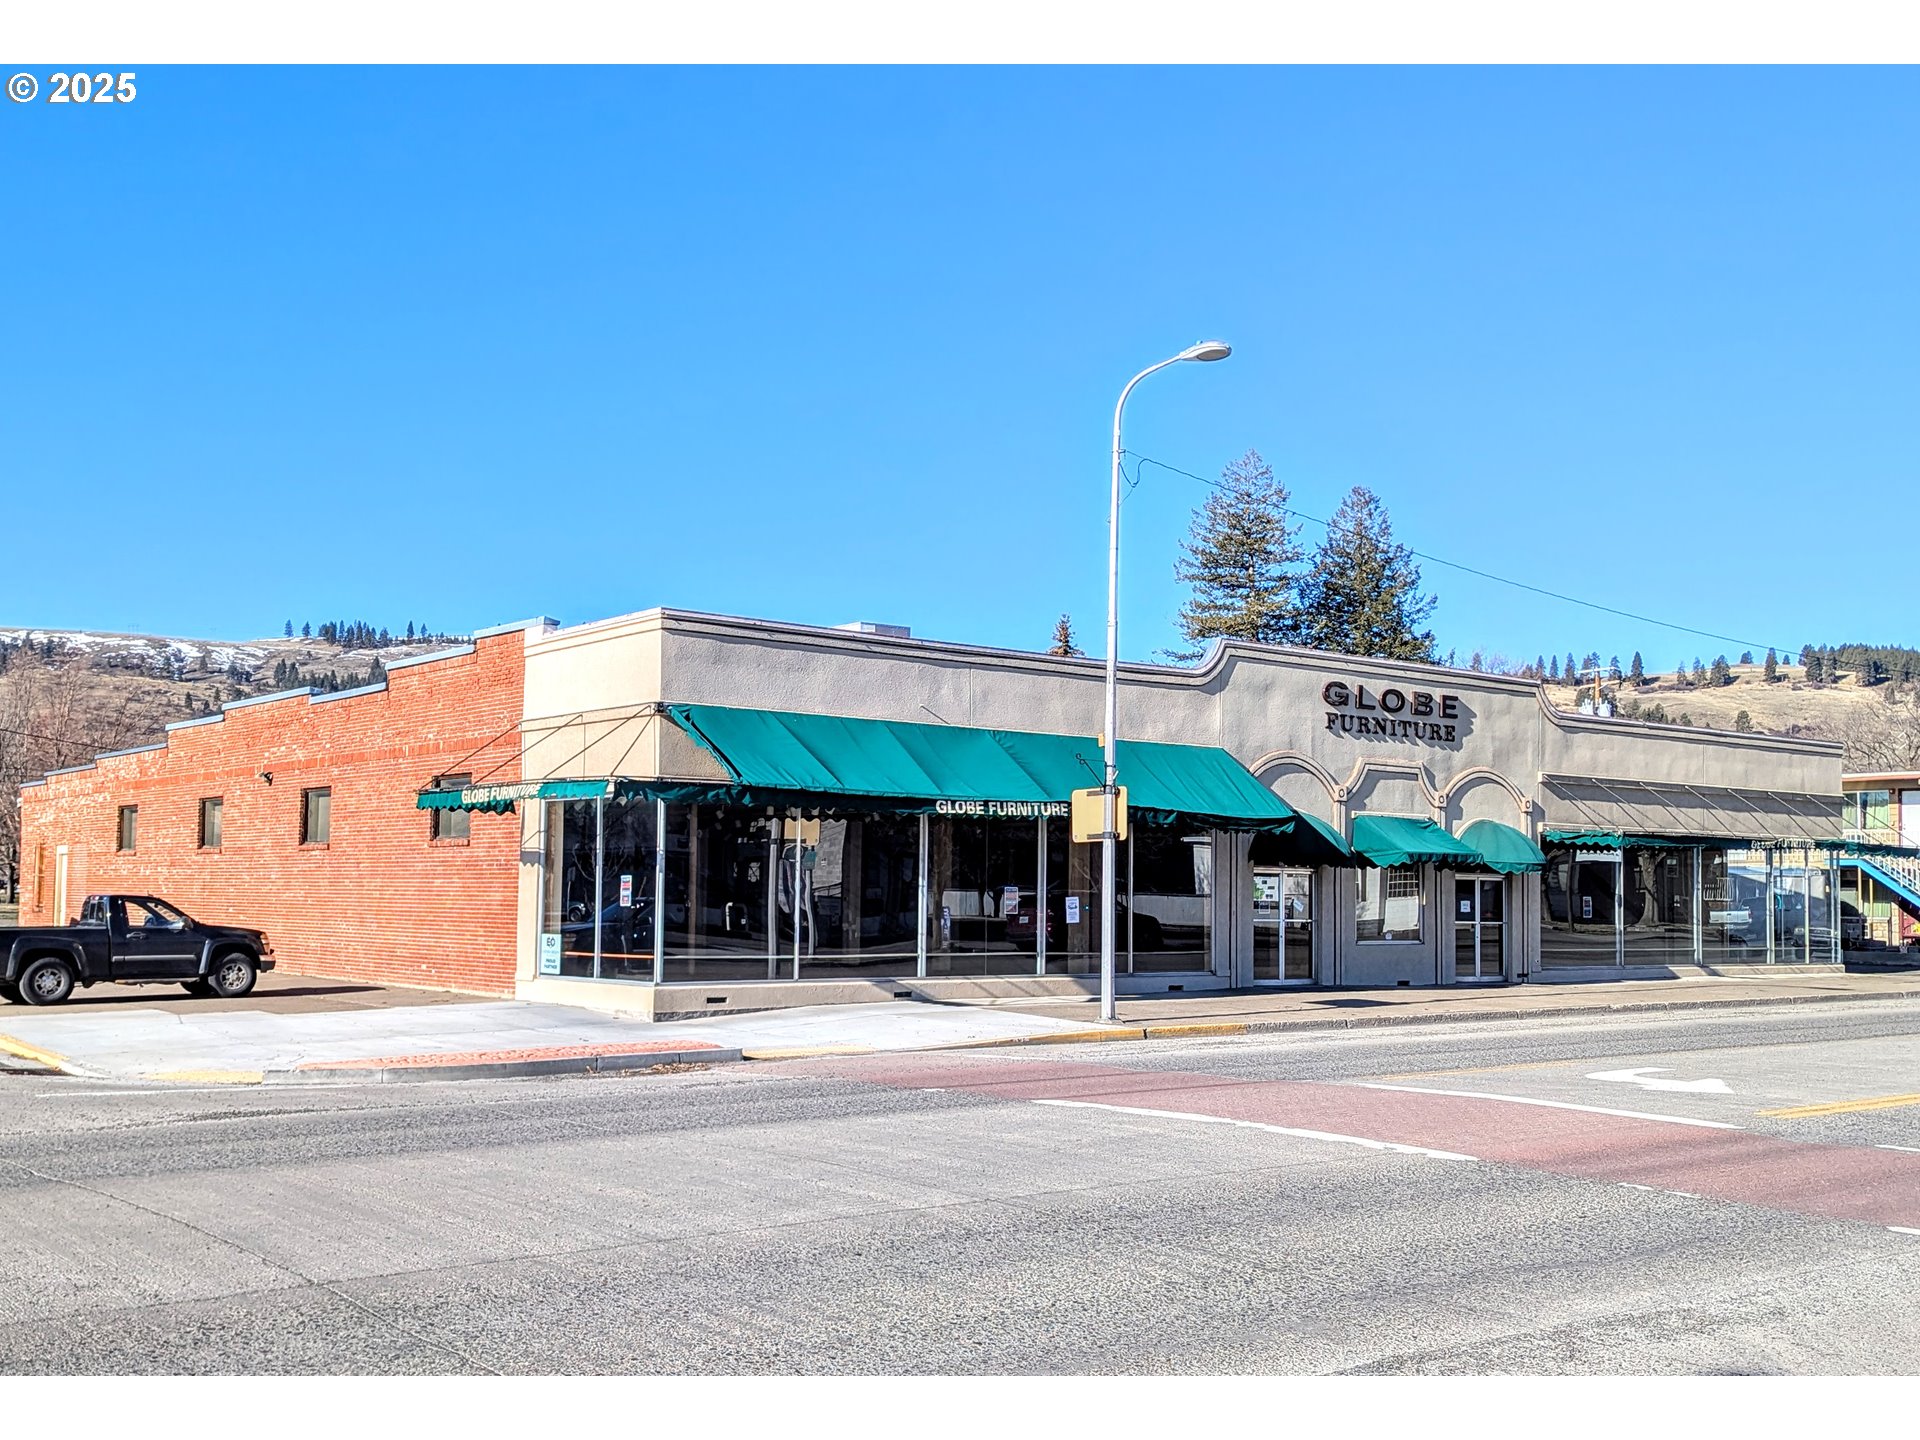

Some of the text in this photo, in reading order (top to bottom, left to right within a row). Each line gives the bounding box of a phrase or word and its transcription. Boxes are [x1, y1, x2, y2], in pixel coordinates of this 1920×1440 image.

[1322, 681, 1459, 719] GLOBE
[1325, 712, 1456, 742] FURNITURE
[461, 784, 542, 804] GLOBE FURNITURE
[935, 800, 1068, 816] GLOBE FURNITURE
